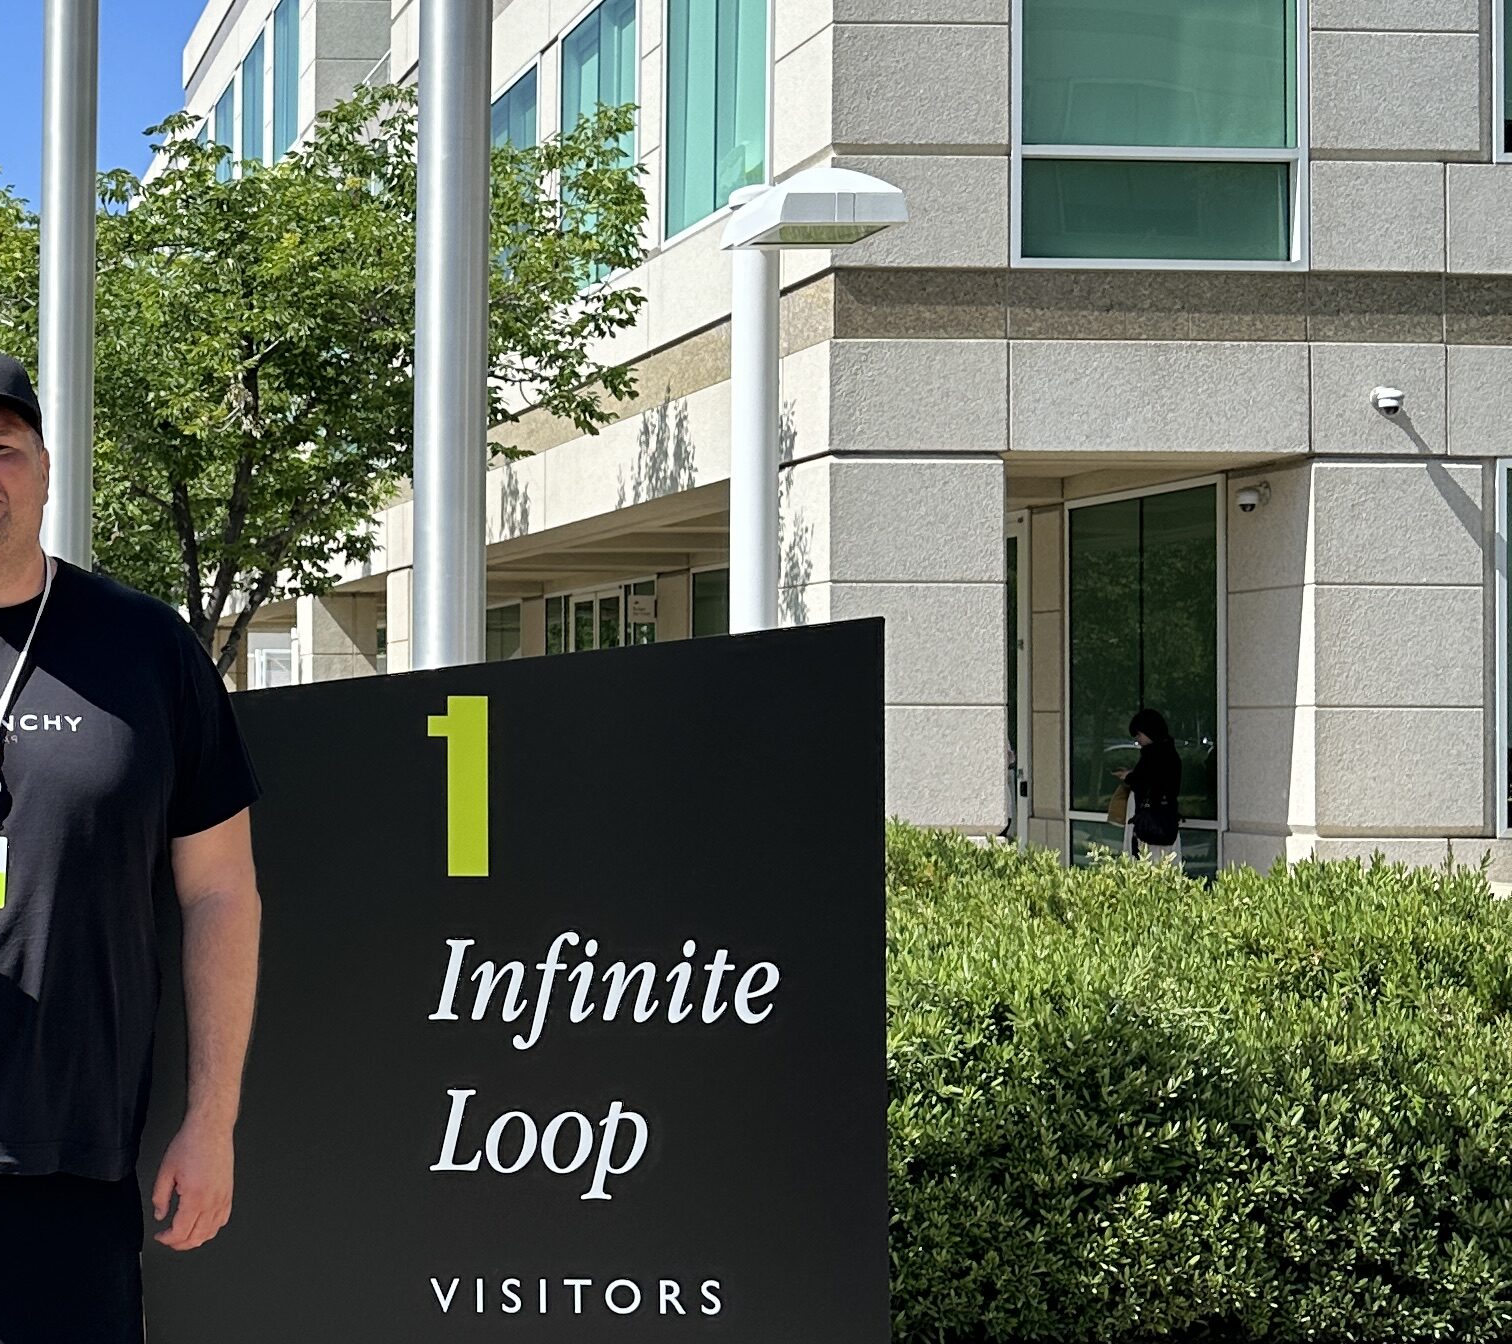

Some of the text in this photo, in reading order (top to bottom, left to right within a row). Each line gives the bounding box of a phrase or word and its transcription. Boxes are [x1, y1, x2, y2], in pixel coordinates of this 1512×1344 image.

[427, 695, 489, 877] 1
[428, 931, 780, 1050] Infinite
[429, 1088, 649, 1200] Loop
[430, 1276, 723, 1316] VISITORS
